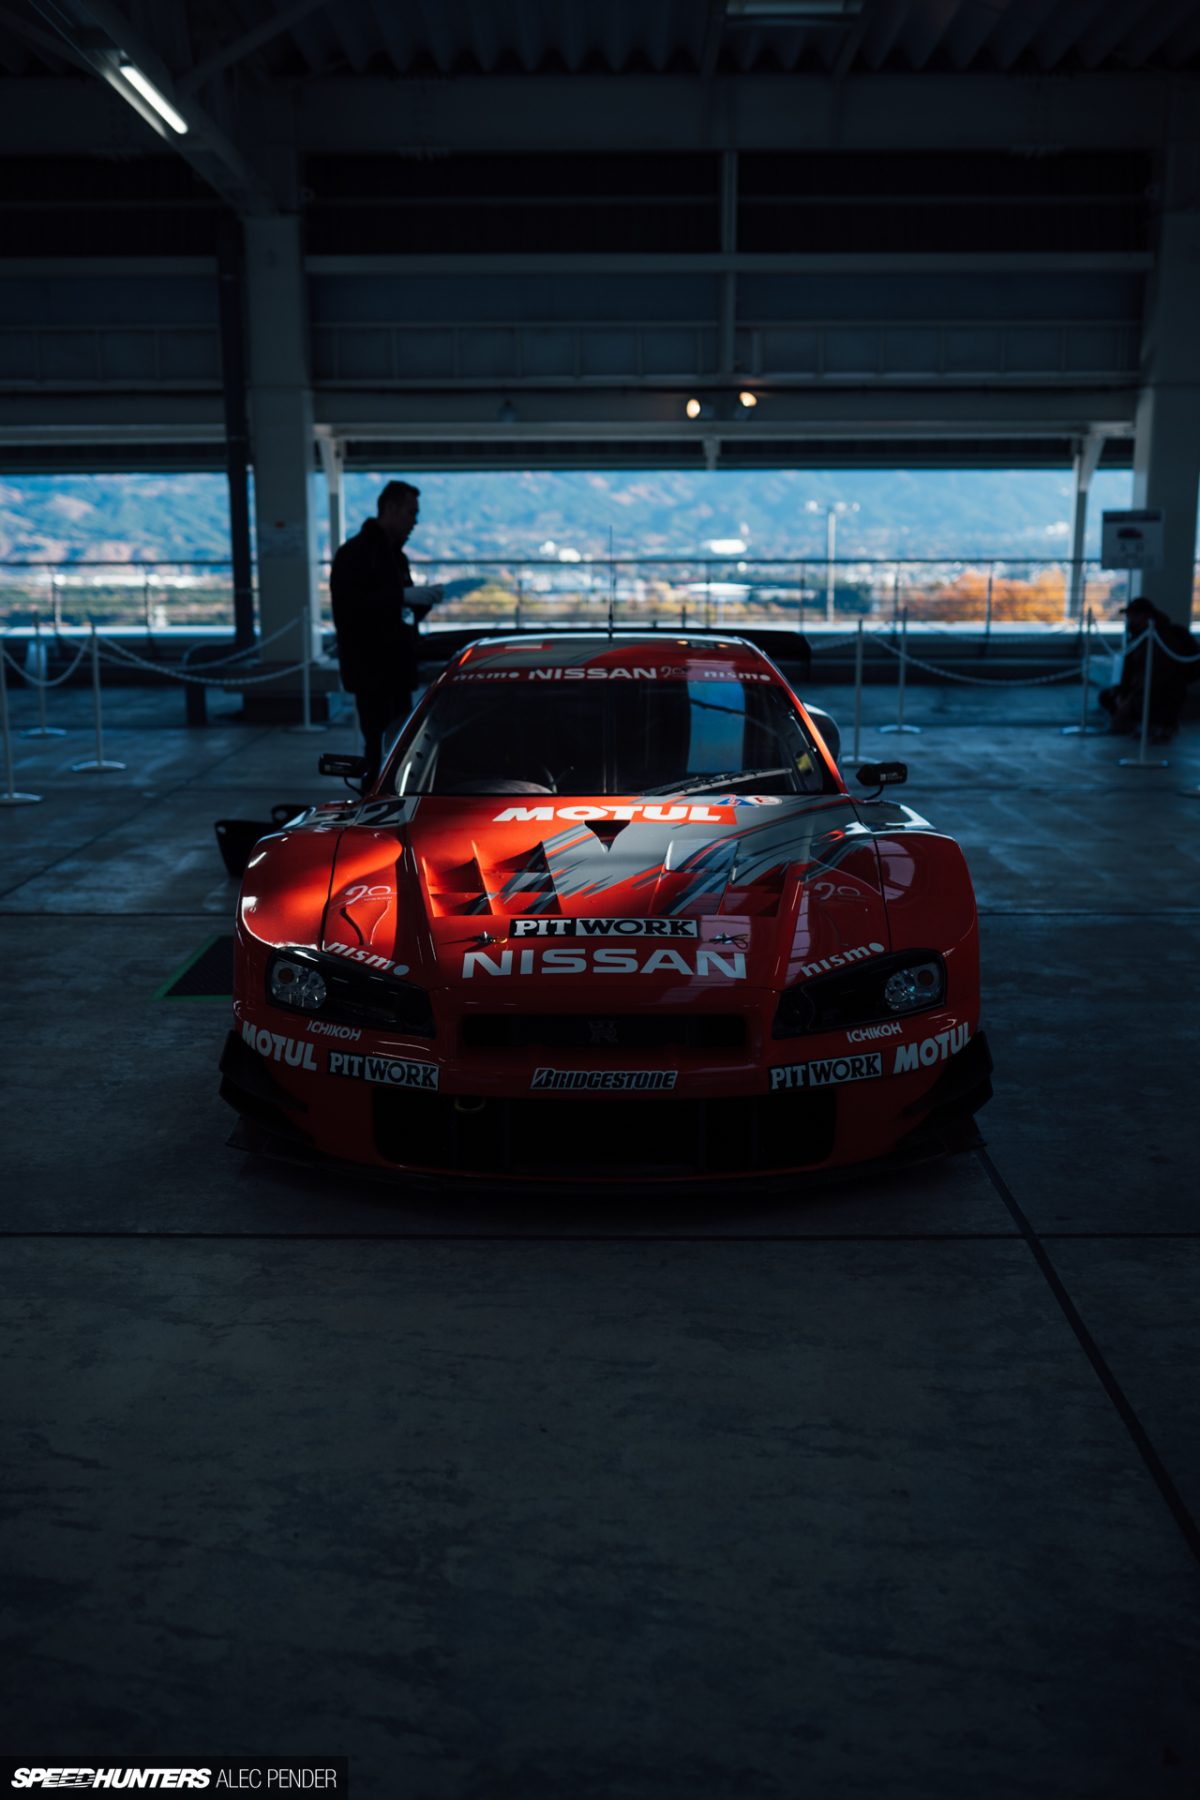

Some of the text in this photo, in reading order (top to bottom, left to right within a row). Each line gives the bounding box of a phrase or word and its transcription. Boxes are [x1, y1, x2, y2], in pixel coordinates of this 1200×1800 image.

[528, 667, 658, 680] NISSAN
[704, 671, 771, 682] nismo
[492, 805, 722, 822] MOTUL
[325, 941, 410, 976] nismo
[461, 948, 747, 980] NISSAN
[800, 942, 885, 978] nismo
[305, 1019, 362, 1042] ICHIKOH
[846, 1021, 903, 1043] ICHIKOH
[241, 1020, 318, 1072] MOTUL
[892, 1021, 972, 1075] MOTUL
[530, 1068, 679, 1090] BRIDGESTONE
